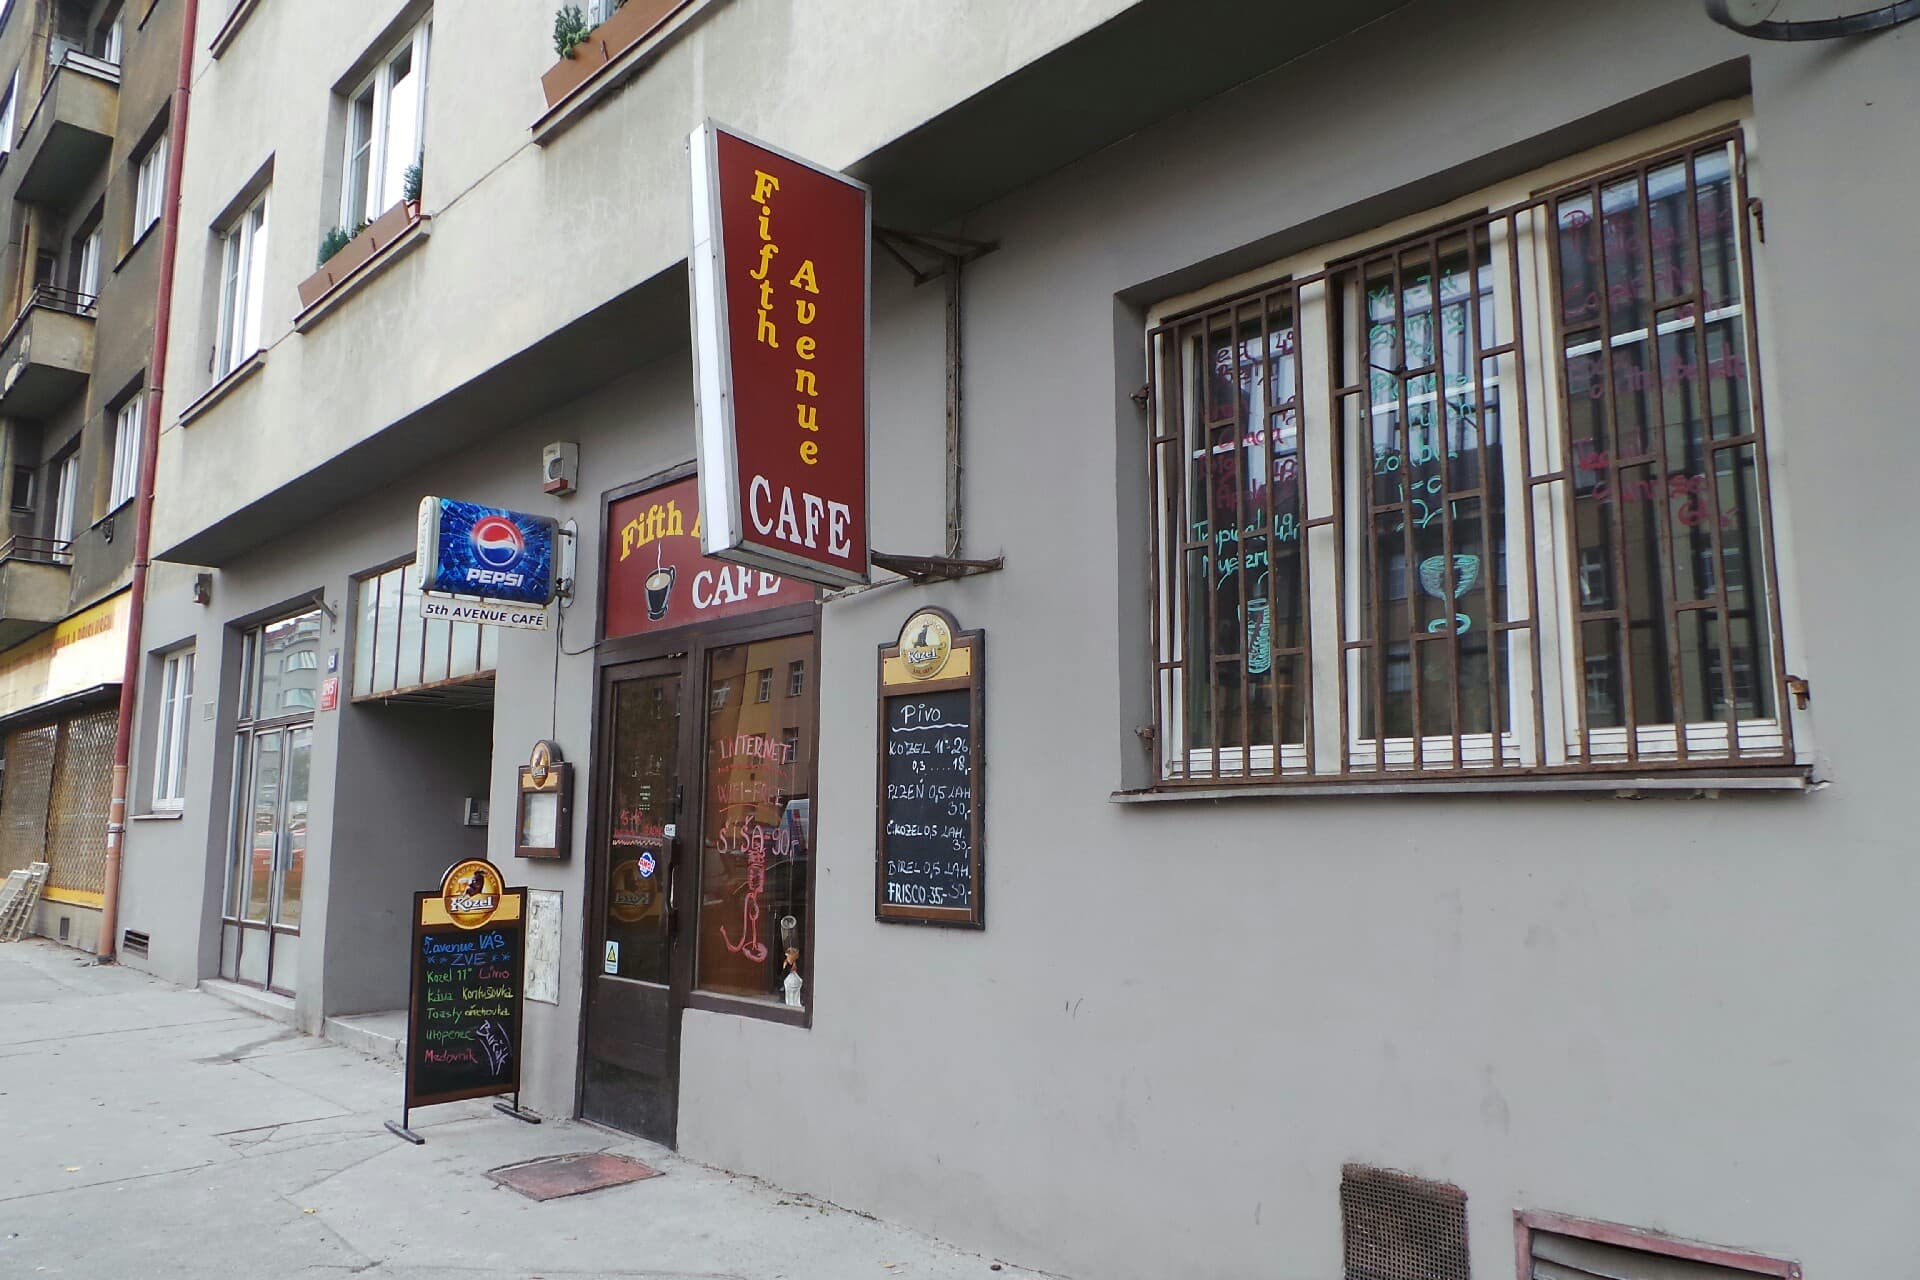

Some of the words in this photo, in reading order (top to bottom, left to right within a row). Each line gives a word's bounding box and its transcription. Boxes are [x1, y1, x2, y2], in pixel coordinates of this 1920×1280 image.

[750, 169, 779, 349] Fifth
[789, 258, 820, 466] Avenue
[749, 475, 852, 559] CAFE
[619, 499, 684, 562] Fifth
[466, 568, 525, 587] PEPSI
[426, 604, 449, 616] 5th
[453, 607, 508, 622] AVENUE
[511, 613, 544, 626] CAFÉ
[908, 647, 941, 664] Kozel
[901, 704, 941, 724] Pivo
[719, 733, 792, 766] INTERNET
[888, 740, 931, 756] KOZEL
[888, 881, 926, 904] FRISCO
[451, 896, 494, 912] Kozel
[480, 930, 505, 950] VÁS
[451, 952, 486, 966] ZVE
[427, 968, 452, 983] Kozel
[426, 1007, 462, 1024] Toasty
